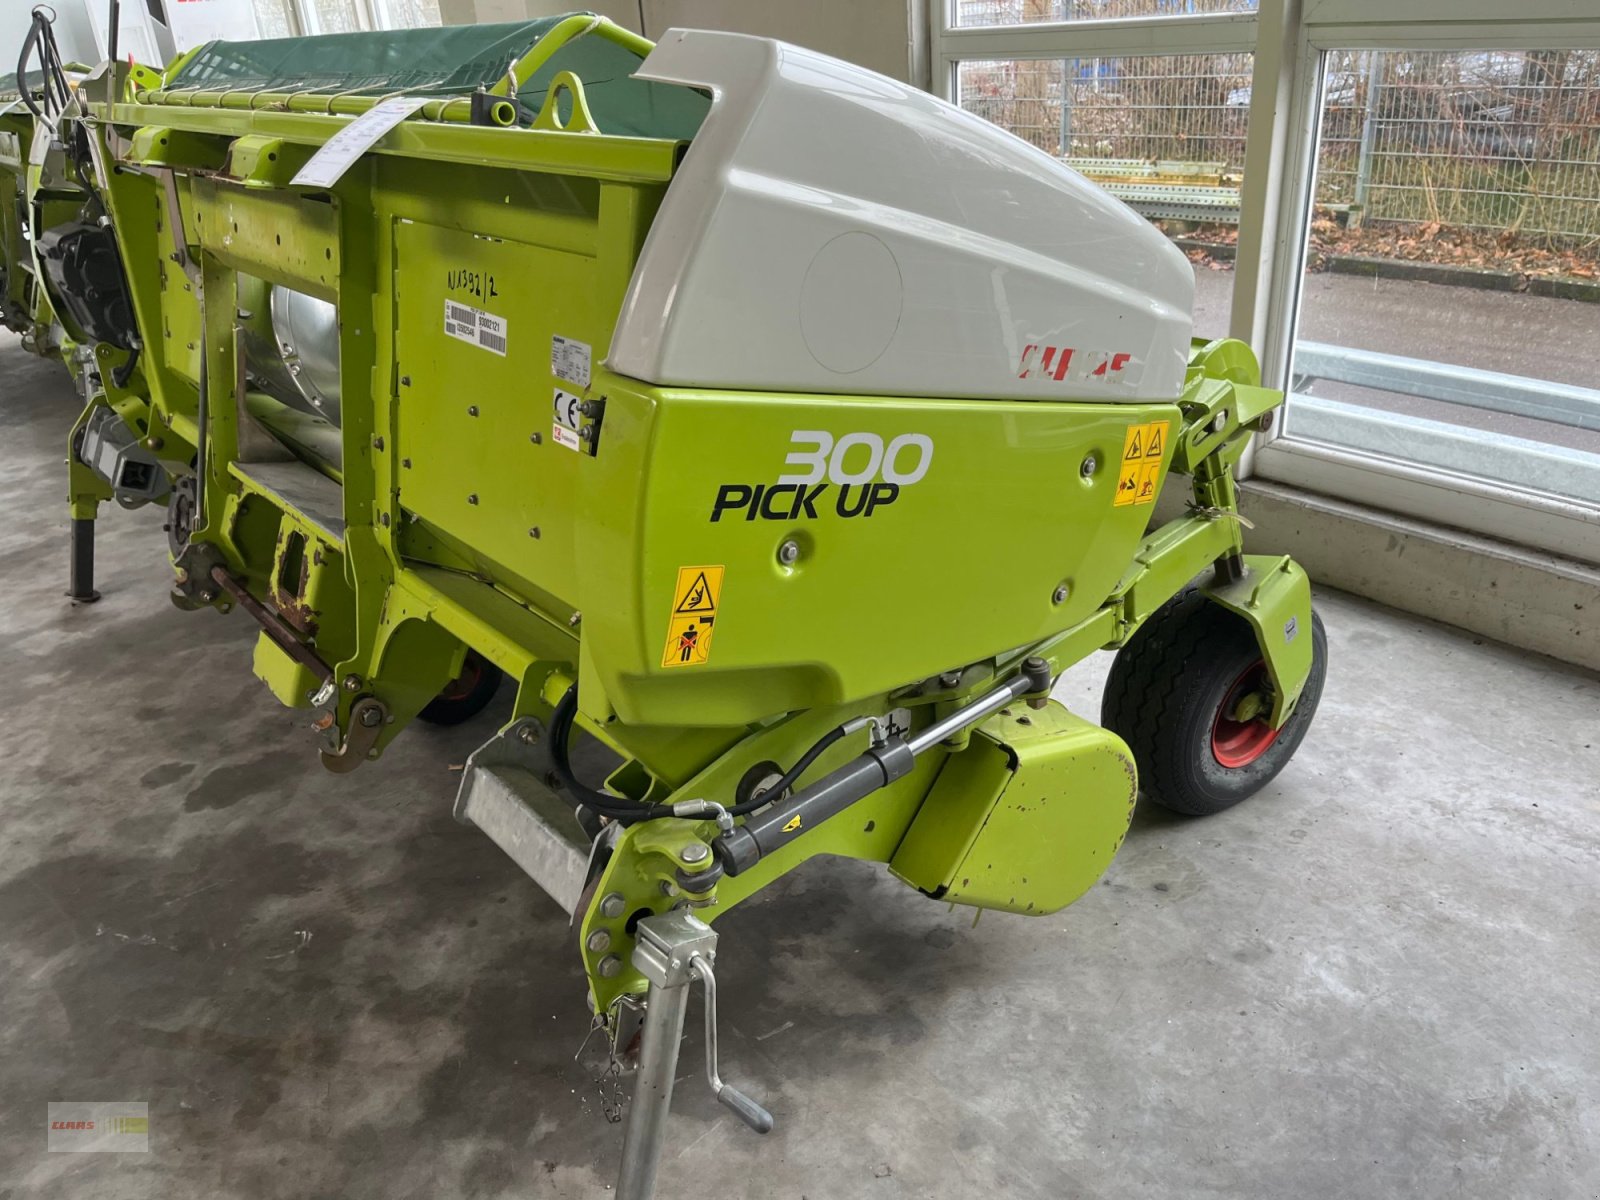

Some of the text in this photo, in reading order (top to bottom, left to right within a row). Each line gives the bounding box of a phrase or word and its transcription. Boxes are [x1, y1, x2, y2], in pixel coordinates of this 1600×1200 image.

[777, 430, 934, 486] 300
[709, 482, 900, 522] PICK UP
